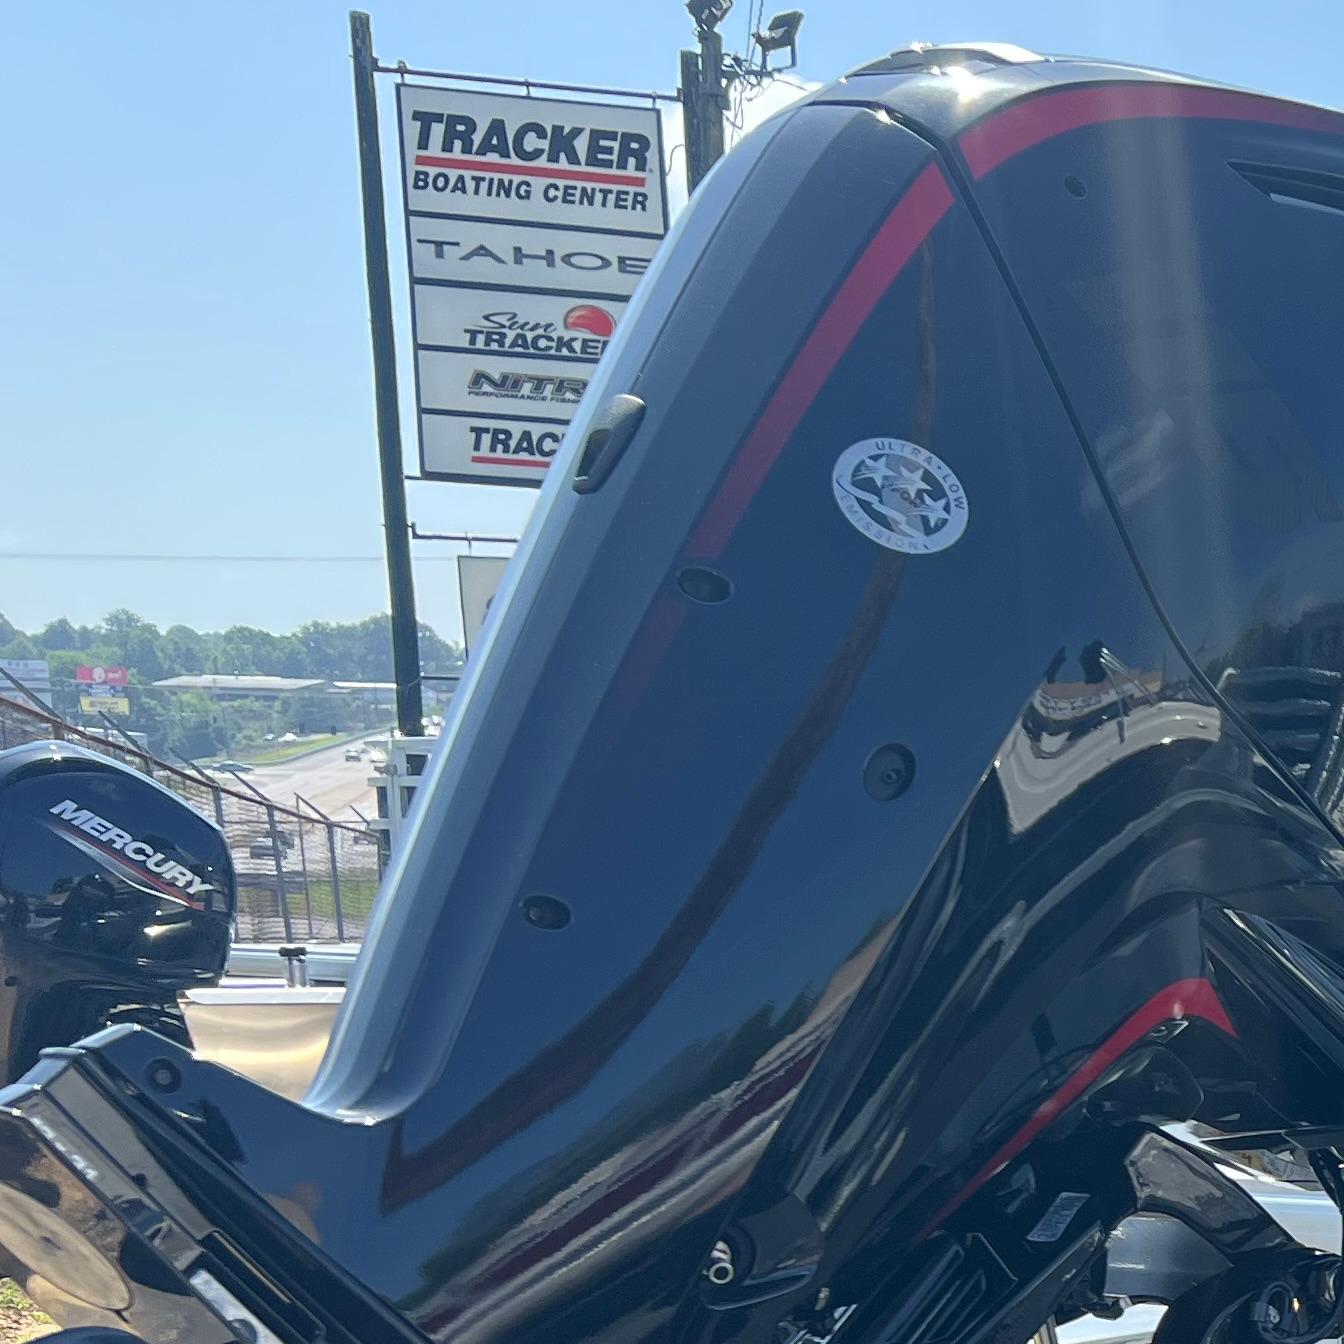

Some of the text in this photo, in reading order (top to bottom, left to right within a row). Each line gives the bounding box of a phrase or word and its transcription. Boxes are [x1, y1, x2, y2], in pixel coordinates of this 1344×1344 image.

[411, 110, 651, 172] TRACKER
[412, 169, 649, 212] BOATING CENTER
[416, 238, 652, 275] TAHOE
[464, 328, 611, 357] TRACKE
[473, 310, 557, 333] Sun
[469, 426, 565, 458] TRAC
[874, 440, 966, 510] ULTRA LOW
[839, 495, 920, 551] EMISSION
[49, 798, 214, 896] MERCURY
